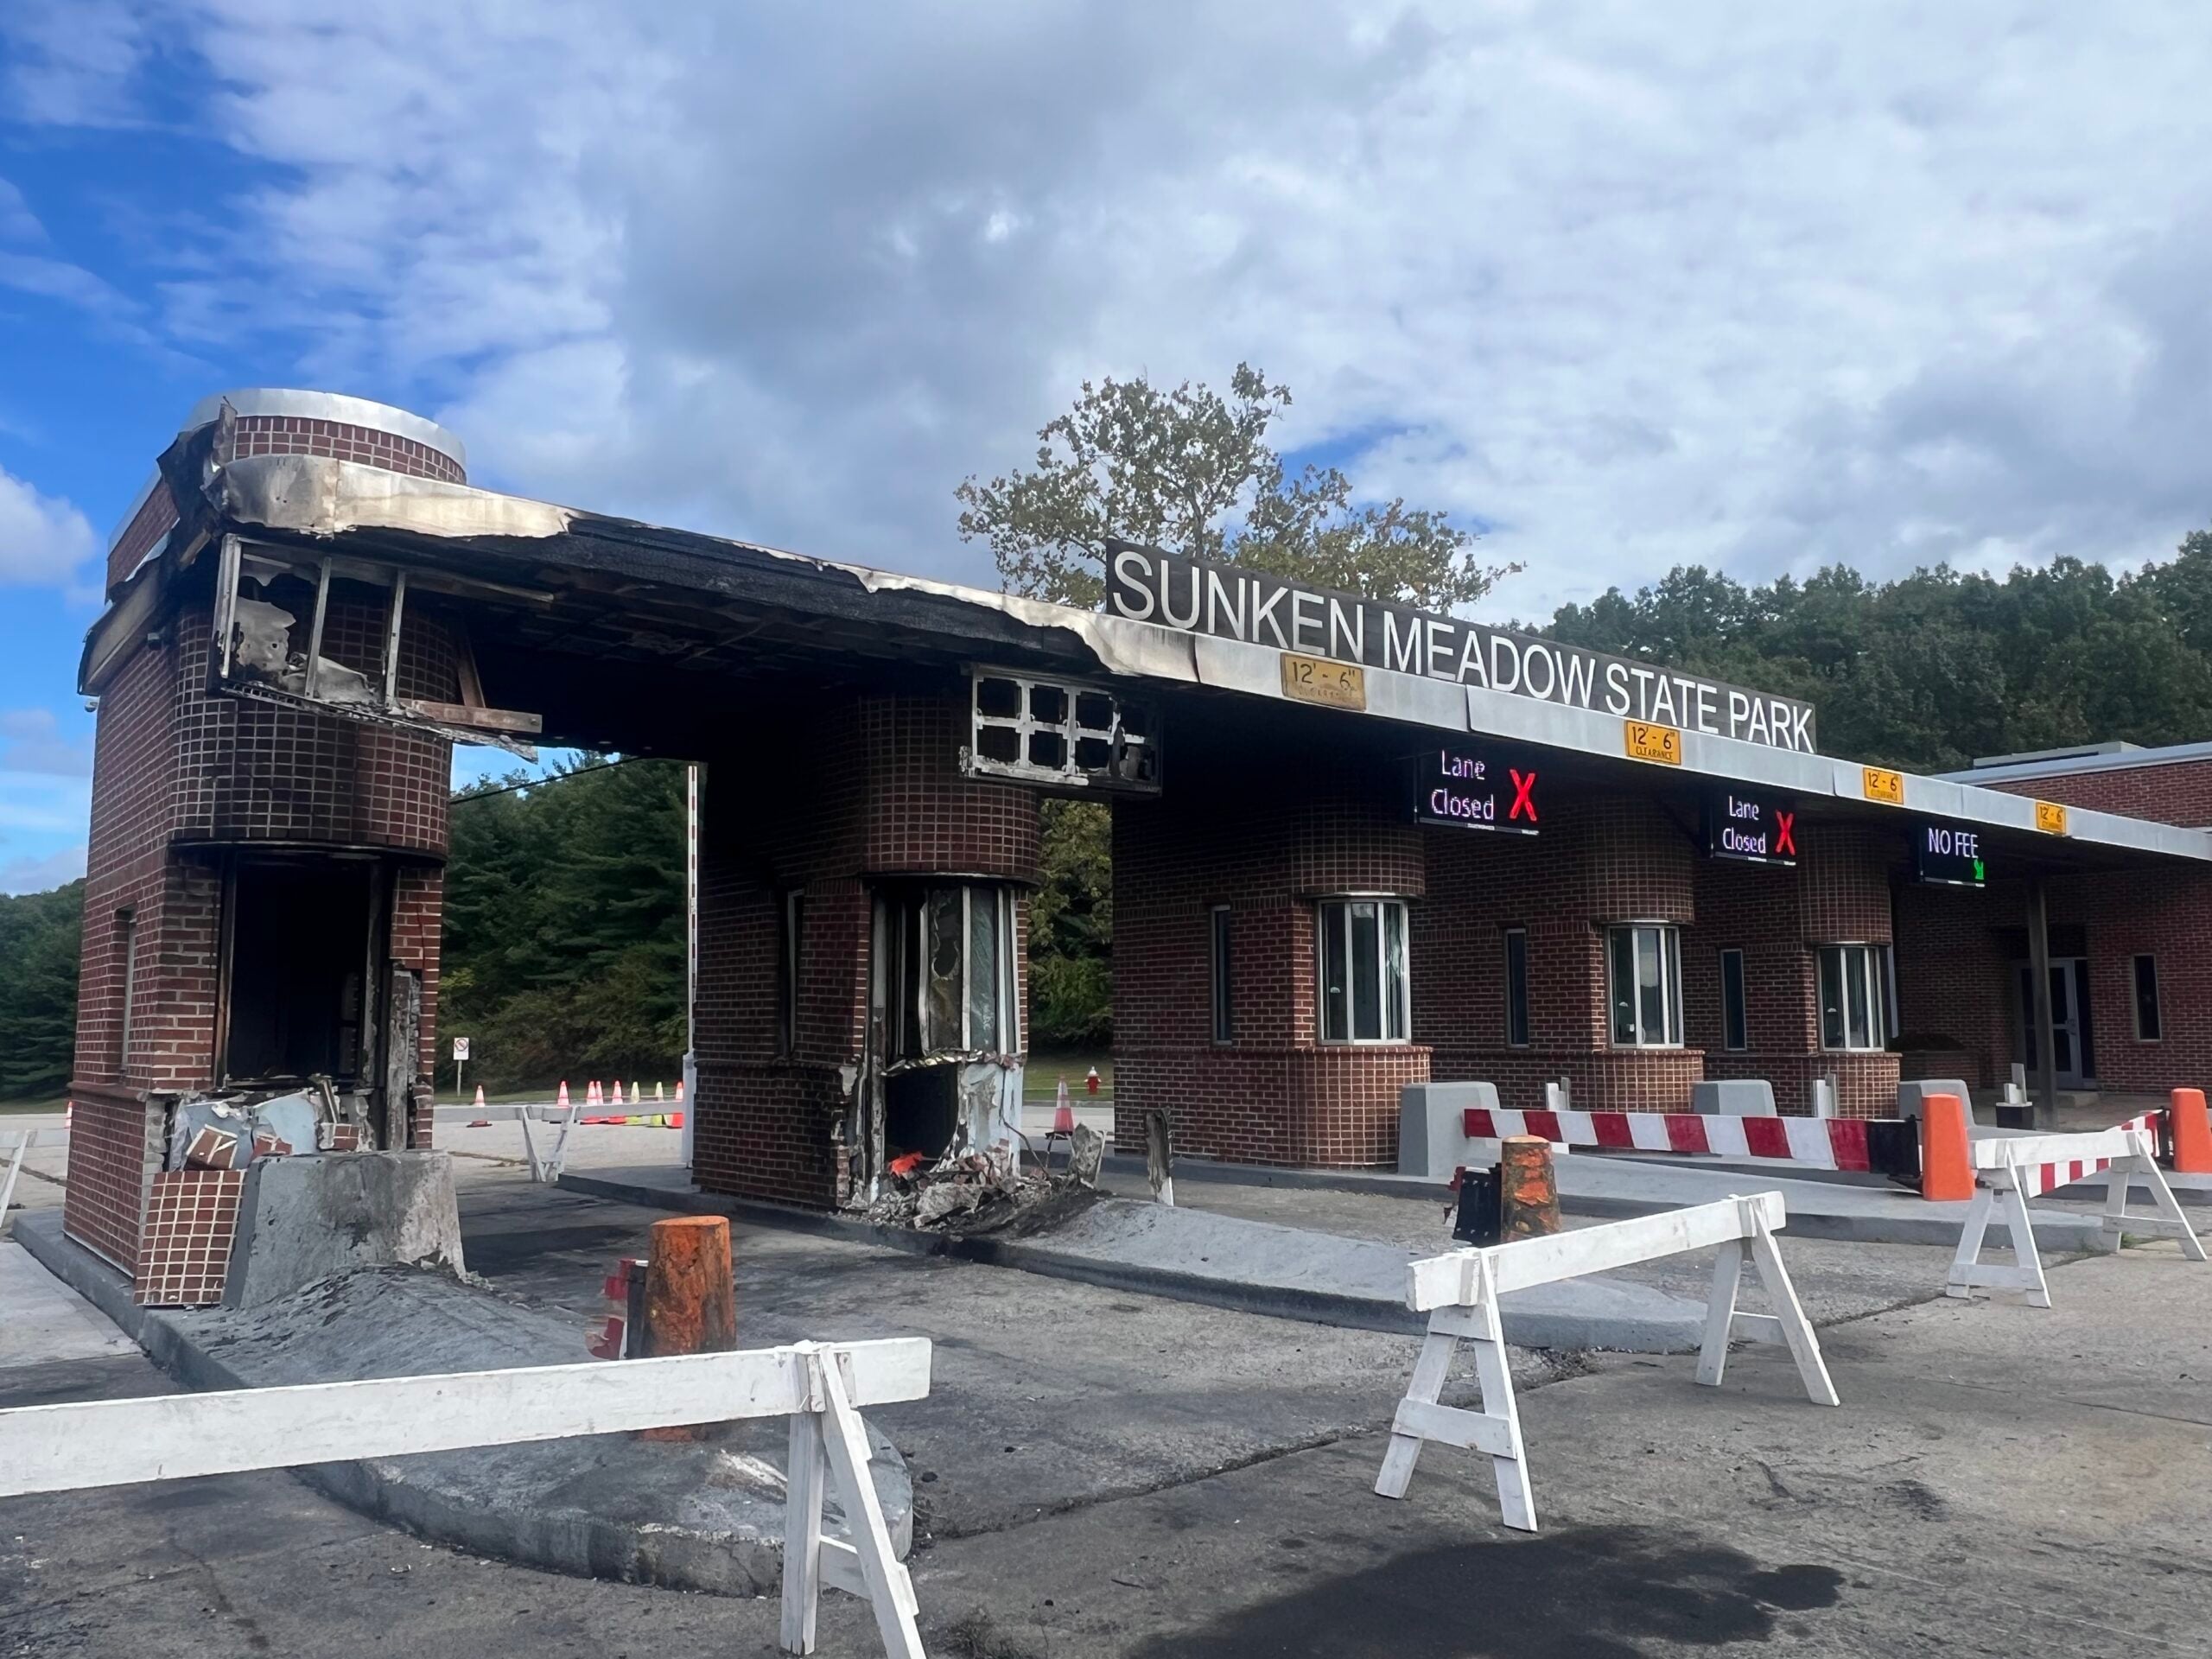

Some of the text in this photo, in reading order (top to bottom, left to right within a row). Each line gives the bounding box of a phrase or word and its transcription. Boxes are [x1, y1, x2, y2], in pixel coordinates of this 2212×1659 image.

[1113, 551, 1815, 754] SUNKEN MEADOW STATE PARK
[1442, 750, 1485, 780] Lane
[1431, 788, 1494, 820] Closed
[1729, 795, 1759, 820] Lane
[1722, 827, 1766, 854] Closed
[1929, 827, 1979, 858] NO FEE
